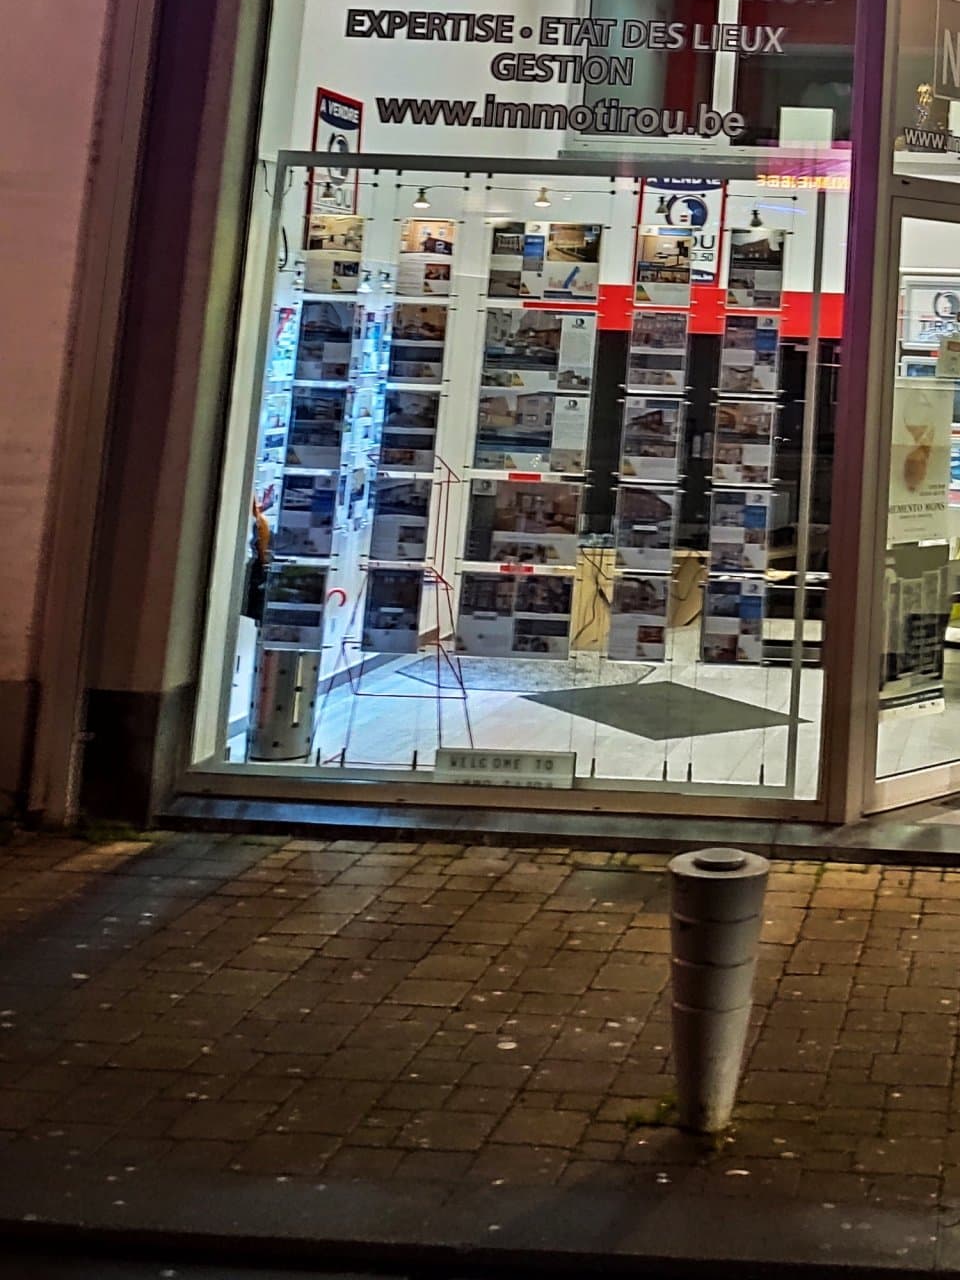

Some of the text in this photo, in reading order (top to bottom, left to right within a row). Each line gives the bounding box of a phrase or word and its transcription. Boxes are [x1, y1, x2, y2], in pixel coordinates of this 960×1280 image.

[345, 8, 785, 54] EXPERTISE ETAT DES LIEUX
[490, 52, 634, 87] GESTION
[375, 93, 746, 138] www.immotirou.be
